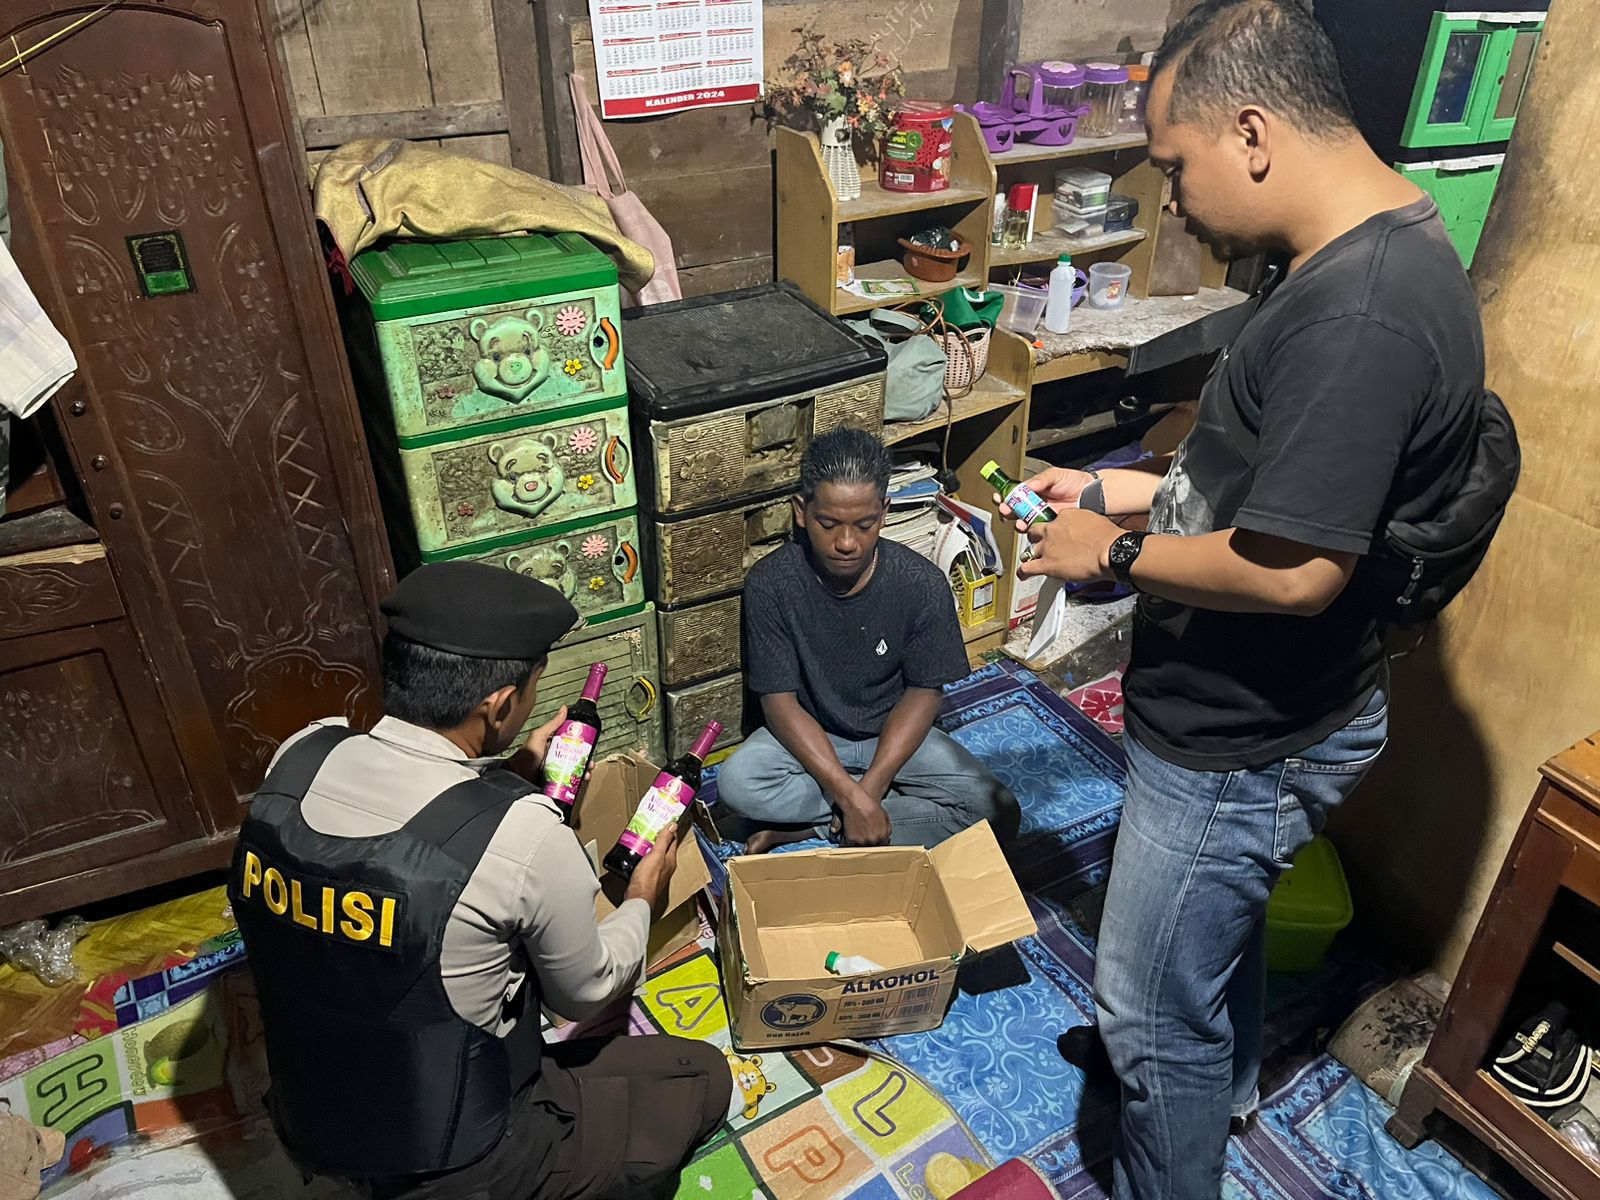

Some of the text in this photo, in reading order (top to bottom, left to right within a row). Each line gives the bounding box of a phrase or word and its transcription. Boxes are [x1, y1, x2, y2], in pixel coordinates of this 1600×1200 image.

[645, 91, 725, 107] KALENDER 2024
[243, 851, 396, 947] POLISI
[841, 969, 940, 995] ALKOHOL
[853, 1071, 907, 1137] L
[763, 1125, 845, 1184] P
